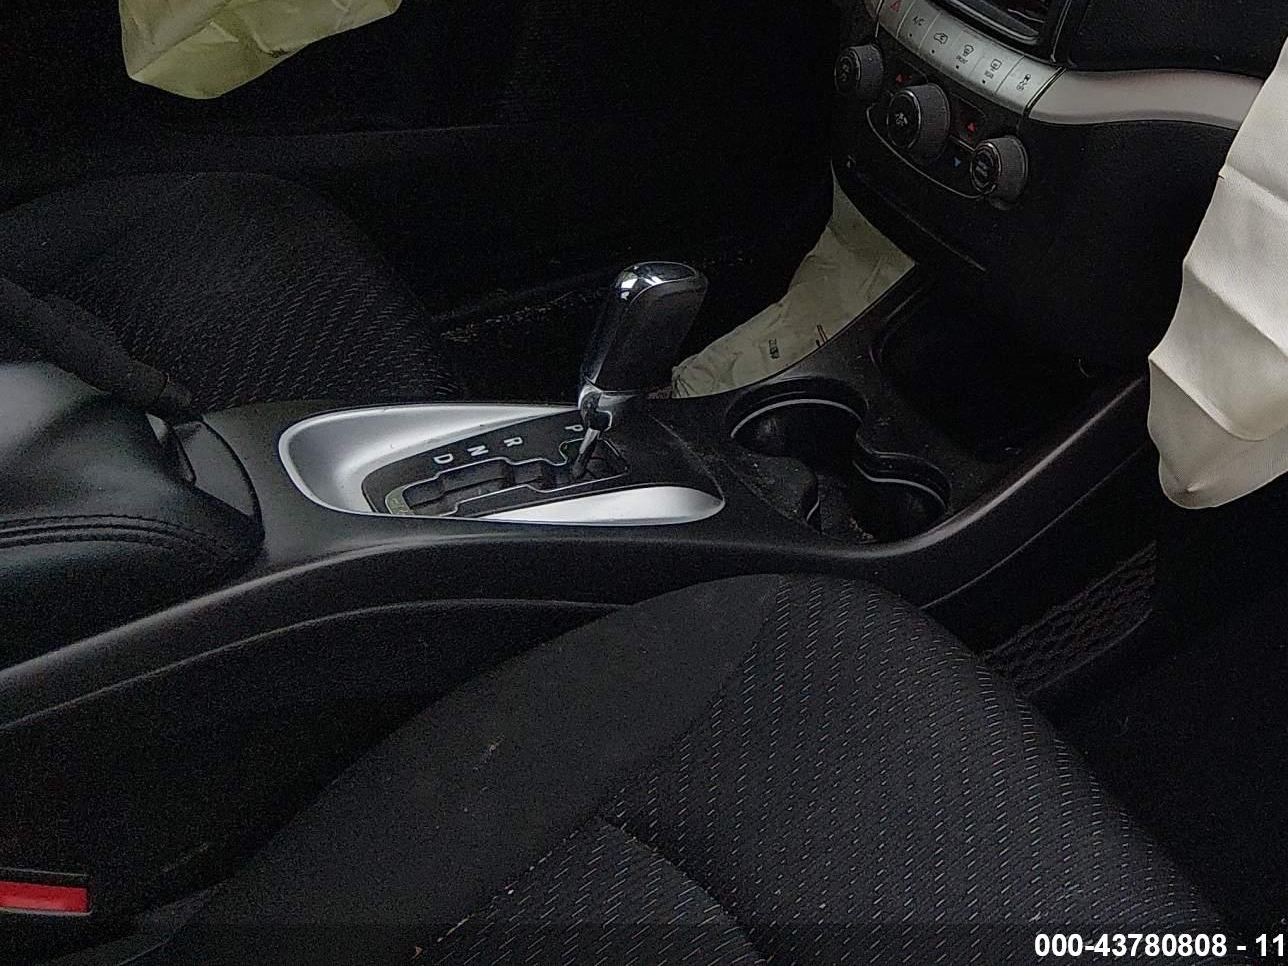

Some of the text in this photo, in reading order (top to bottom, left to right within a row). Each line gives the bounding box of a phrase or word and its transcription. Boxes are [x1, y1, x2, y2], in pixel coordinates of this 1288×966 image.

[564, 424, 584, 432] P
[504, 437, 523, 447] R
[467, 445, 489, 457] N
[433, 453, 454, 465] D
